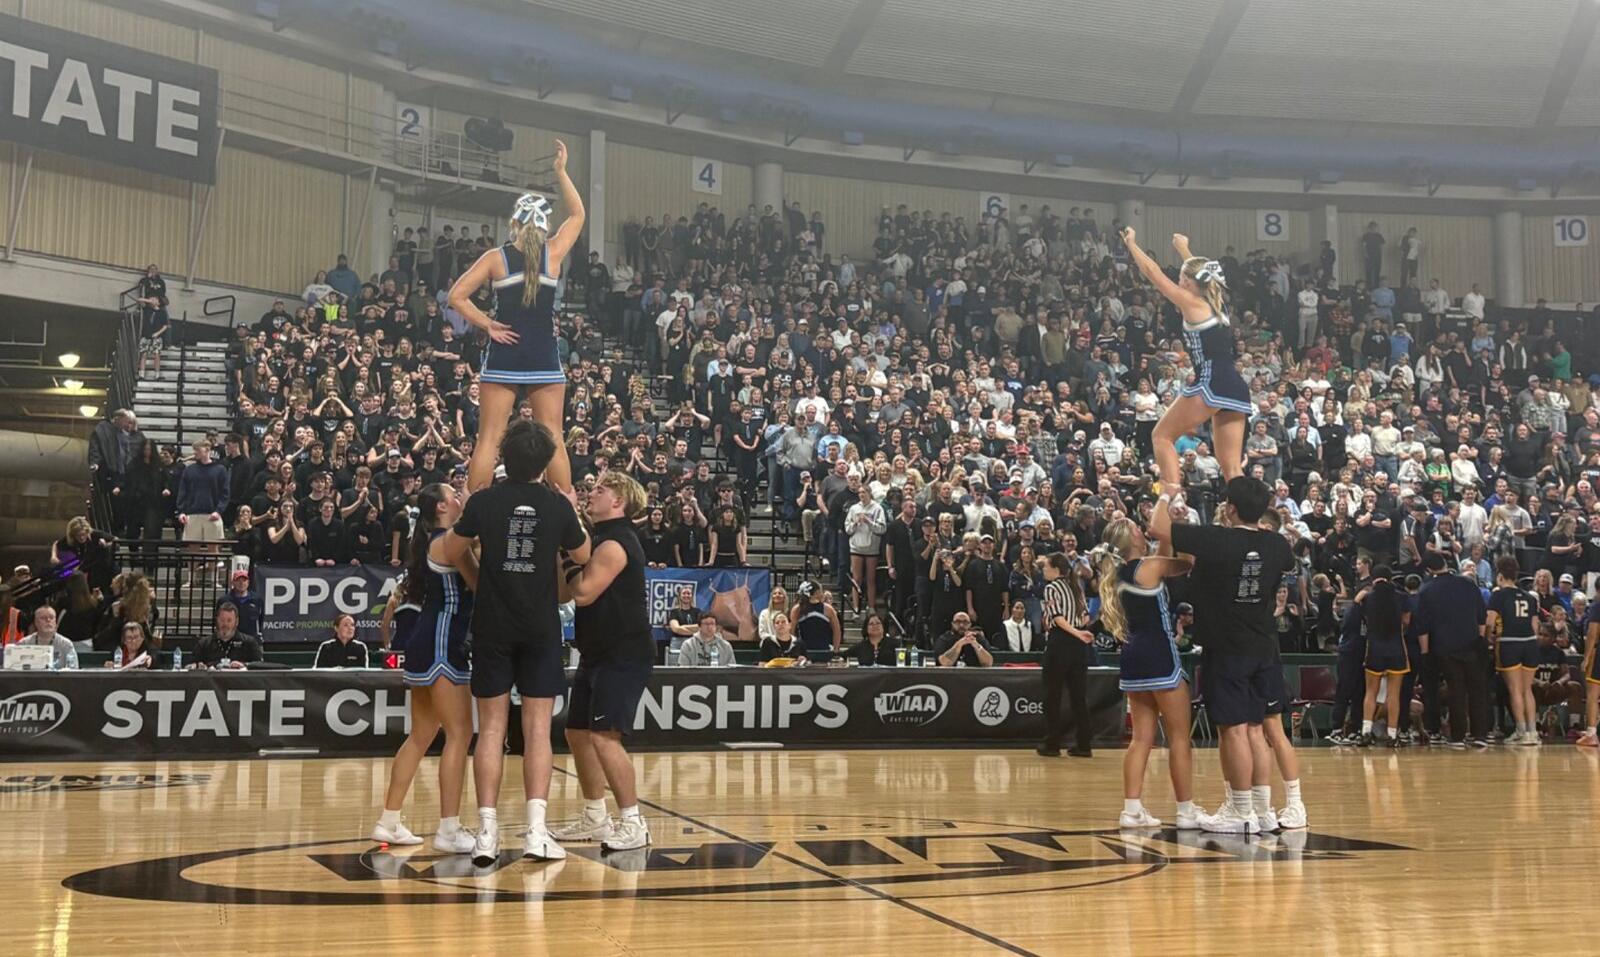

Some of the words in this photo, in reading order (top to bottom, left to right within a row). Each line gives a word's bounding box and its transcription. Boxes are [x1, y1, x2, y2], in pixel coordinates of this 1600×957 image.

[401, 108, 420, 136] 2
[698, 163, 716, 188] 4
[986, 196, 1003, 218] 6
[1264, 213, 1282, 236] 8
[1555, 218, 1586, 241] 10
[1515, 600, 1529, 617] 12
[263, 620, 295, 629] PACIFIC
[101, 688, 305, 739] STATE
[885, 695, 937, 712] WIAA
